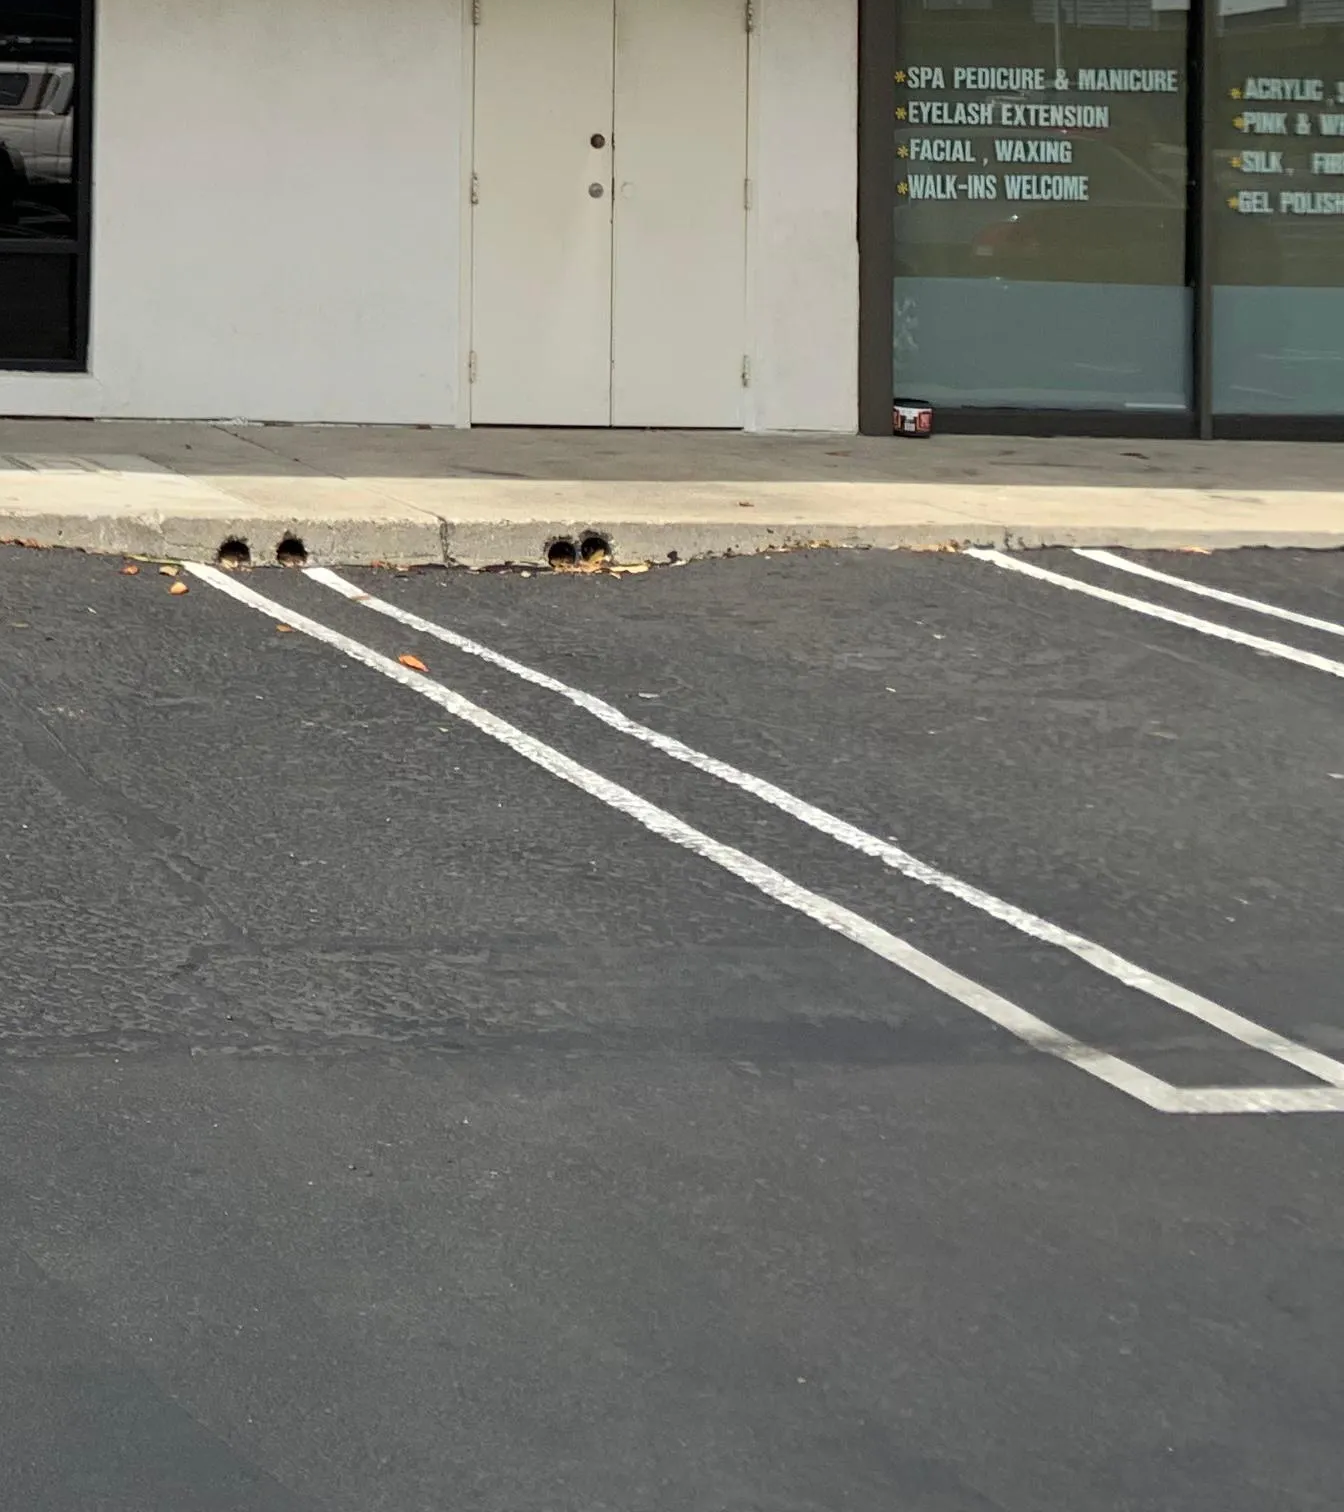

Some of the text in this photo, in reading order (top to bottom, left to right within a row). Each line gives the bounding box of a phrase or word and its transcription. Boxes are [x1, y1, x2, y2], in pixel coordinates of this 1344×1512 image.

[907, 67, 1178, 92] SPA PEDICURE & MANICURE
[908, 101, 1109, 128] EYELASH EXTENSION
[1242, 112, 1288, 134] PINK
[1296, 112, 1312, 135] &
[995, 140, 1073, 163] WAXING
[908, 174, 1089, 201] WALK-INS WELCOME
[1238, 191, 1274, 213] GEL
